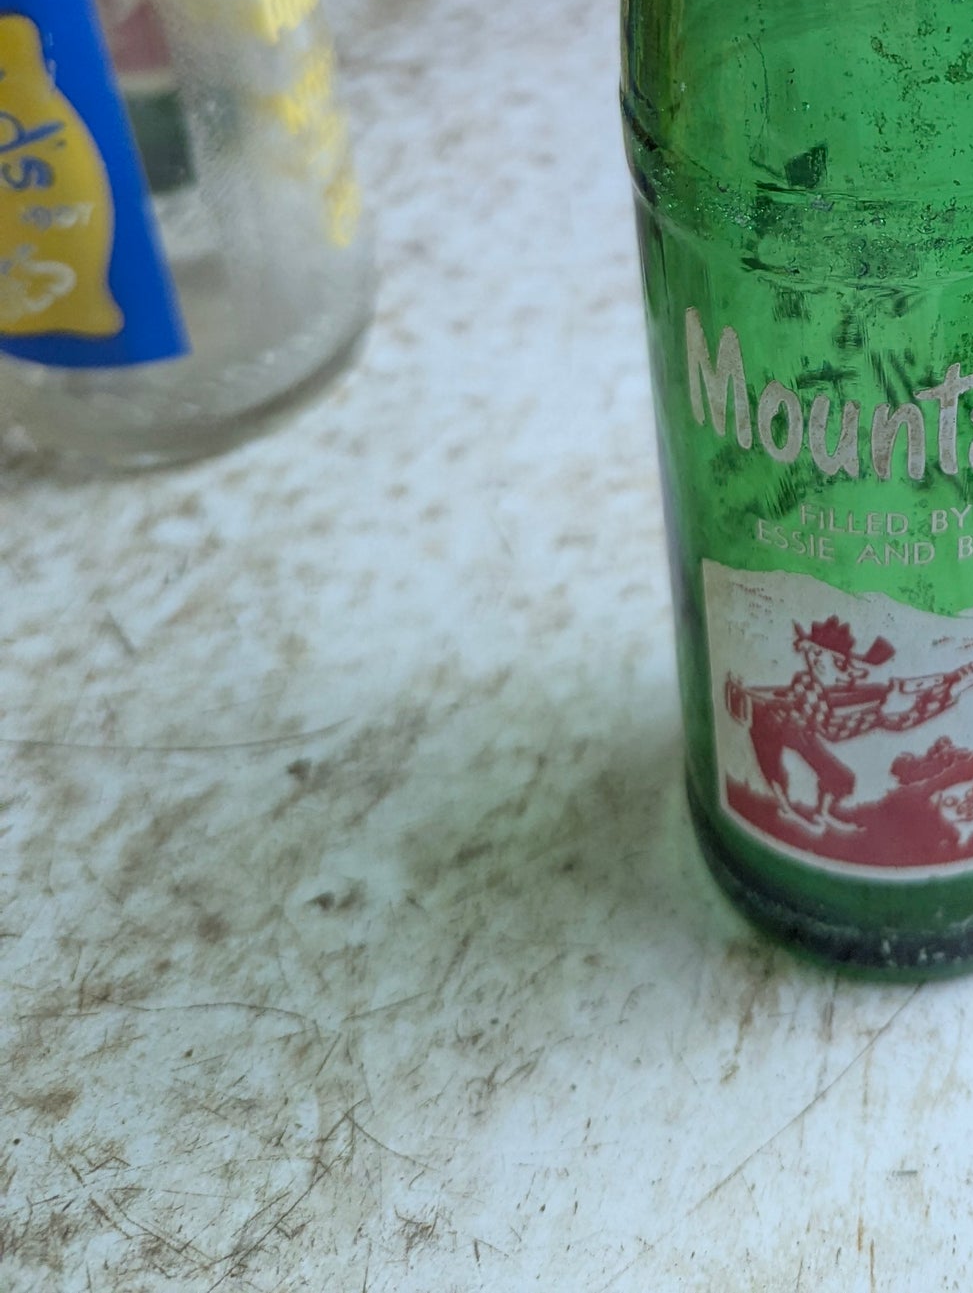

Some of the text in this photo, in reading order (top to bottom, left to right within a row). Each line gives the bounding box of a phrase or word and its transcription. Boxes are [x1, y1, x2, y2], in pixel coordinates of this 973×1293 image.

[800, 504, 973, 536] FILLED BY
[757, 518, 836, 559] ESSIE
[855, 542, 935, 565] AND
